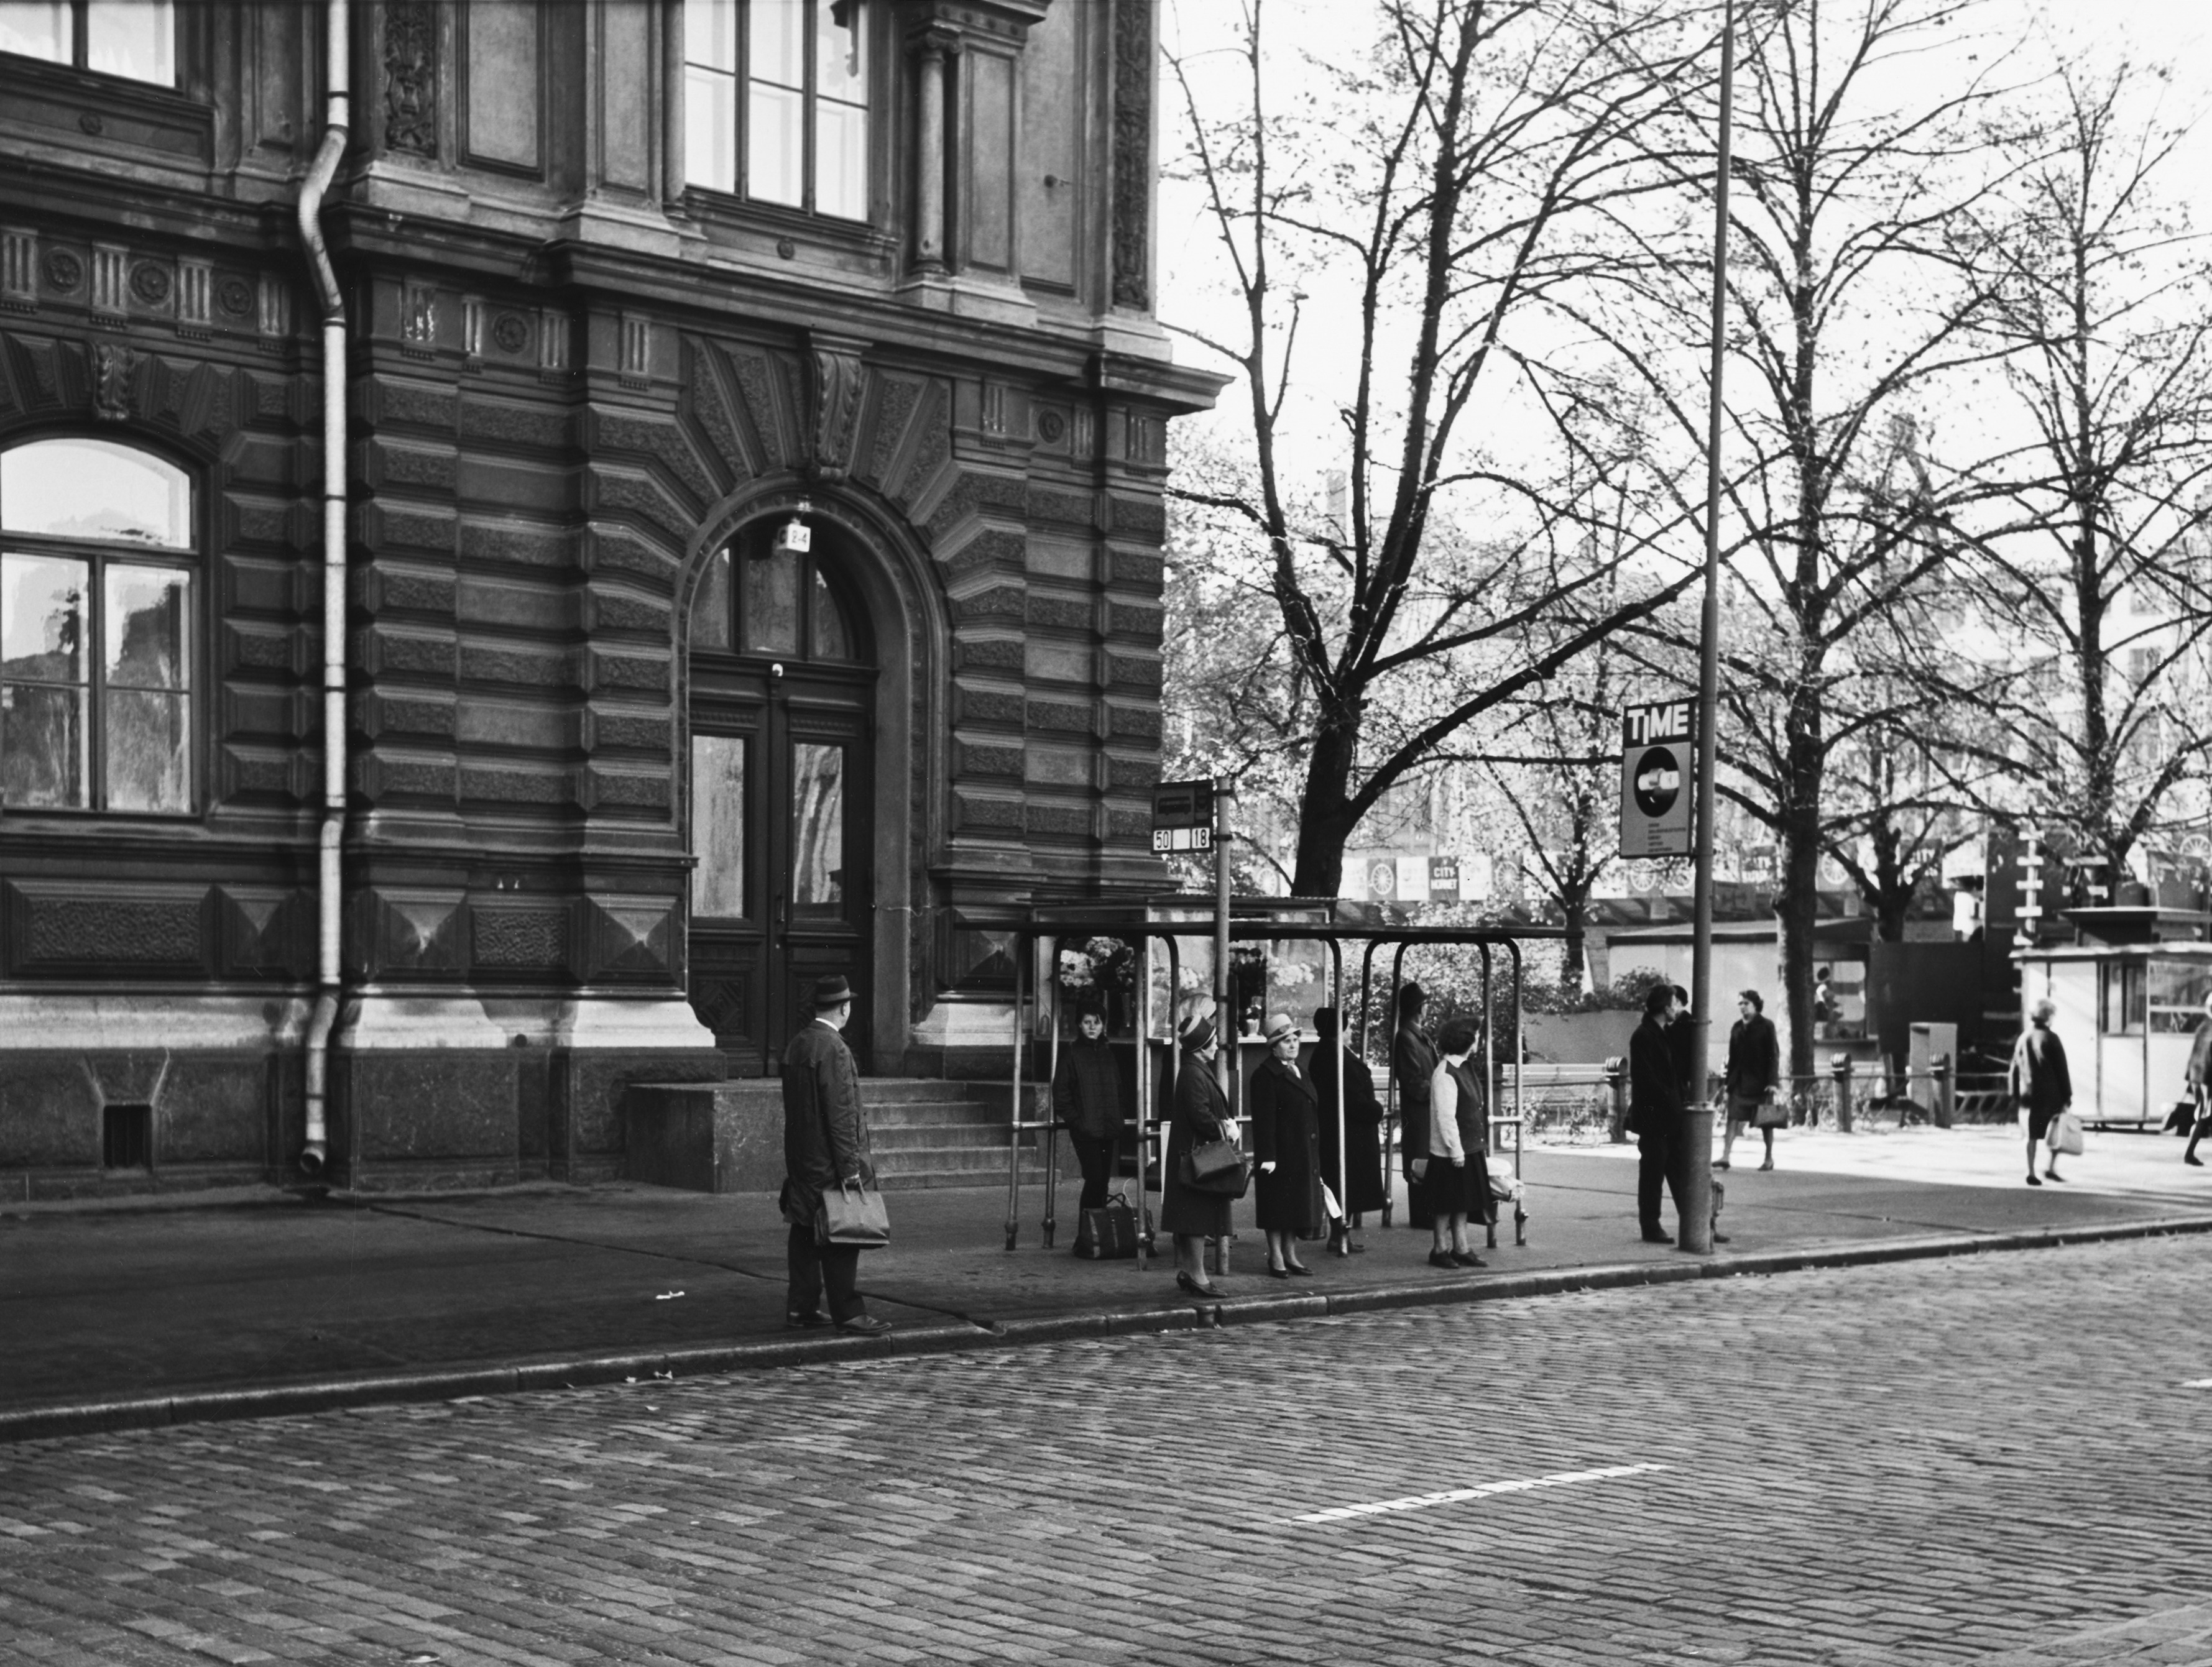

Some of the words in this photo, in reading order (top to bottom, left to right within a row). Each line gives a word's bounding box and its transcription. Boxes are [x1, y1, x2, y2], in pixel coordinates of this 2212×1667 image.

[1627, 703, 1689, 745] TIME
[1156, 830, 1169, 849] 50
[1195, 828, 1207, 847] 18
